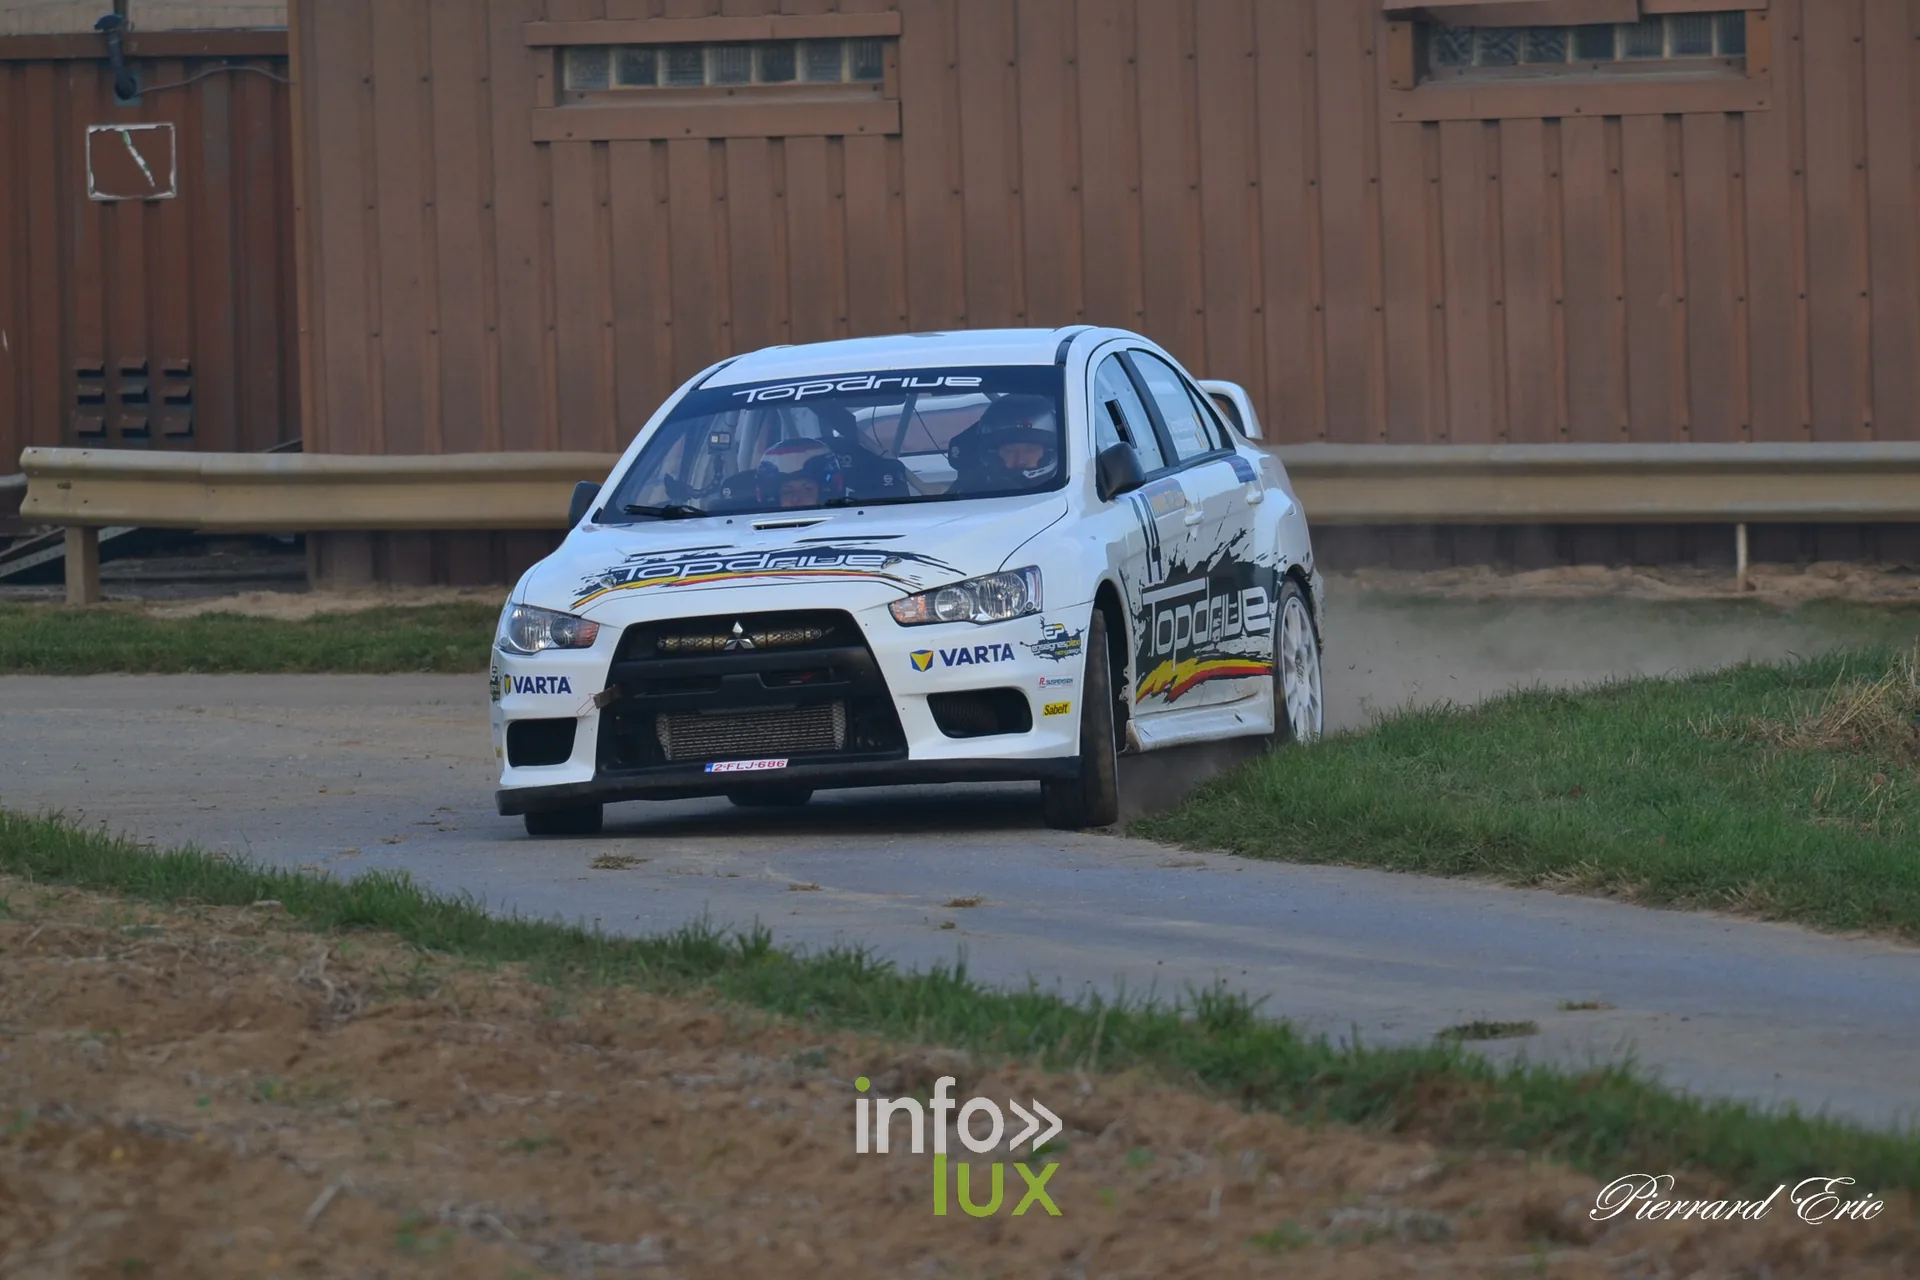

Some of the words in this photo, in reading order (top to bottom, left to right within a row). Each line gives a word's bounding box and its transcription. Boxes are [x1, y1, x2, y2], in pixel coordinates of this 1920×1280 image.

[939, 643, 1016, 667] VARTA
[513, 676, 572, 694] VARTA
[1044, 703, 1069, 716] Sabelt
